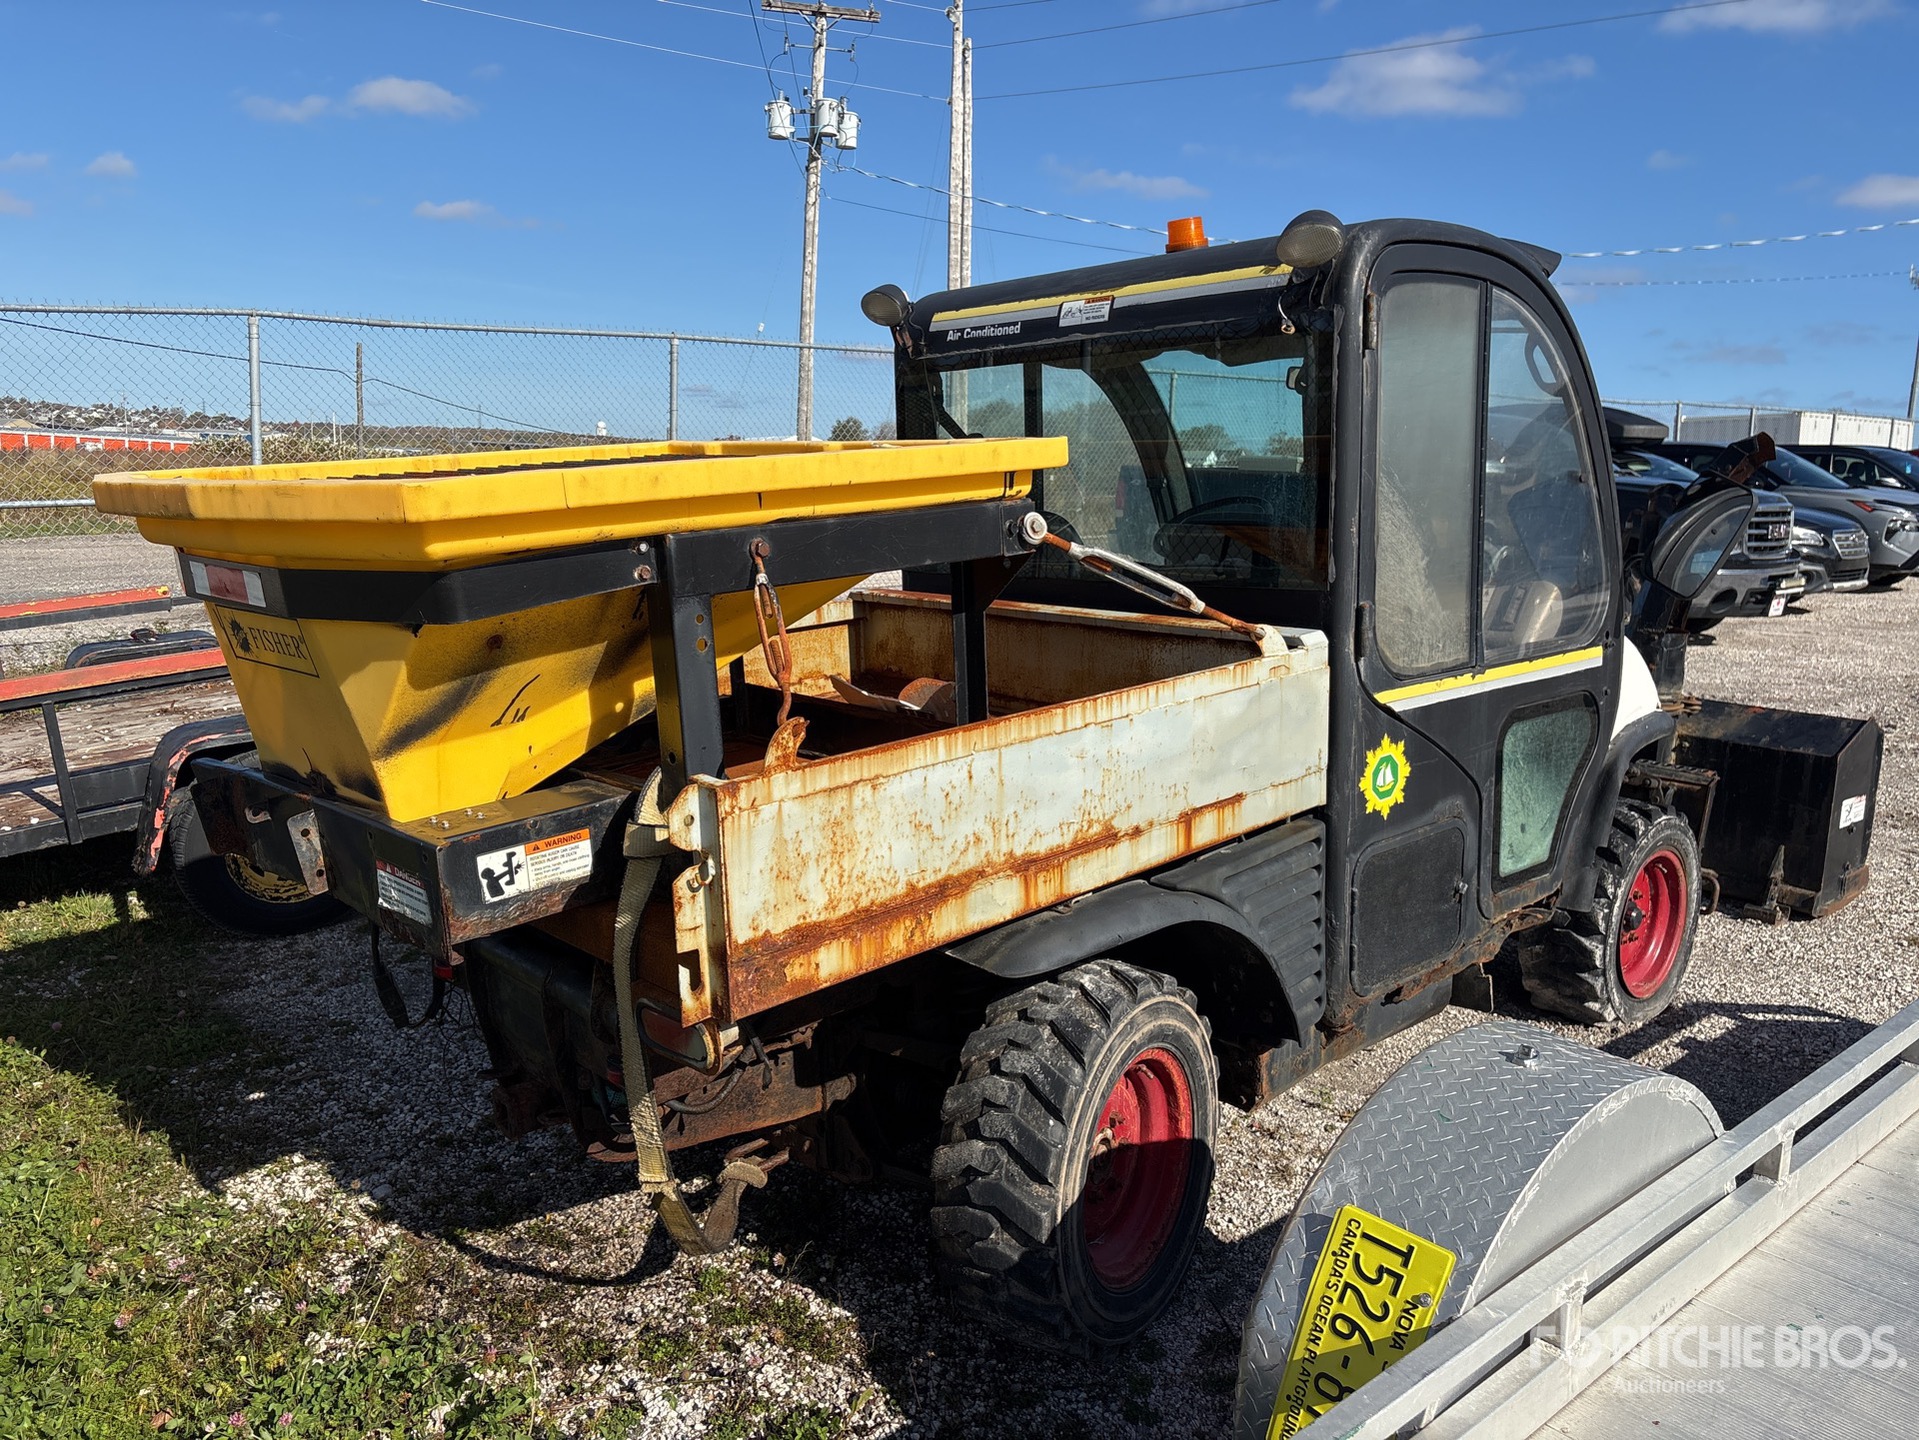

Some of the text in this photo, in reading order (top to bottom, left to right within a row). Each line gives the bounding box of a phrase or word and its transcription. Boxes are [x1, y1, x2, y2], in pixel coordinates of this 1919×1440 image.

[946, 321, 1021, 342] Air Conditioned
[544, 832, 582, 848] WARNING
[1324, 1218, 1362, 1293] CANADA'S
[1306, 1231, 1415, 1419] T526-8
[1307, 1294, 1334, 1347] OCEAN
[1388, 1299, 1420, 1351] NOVA
